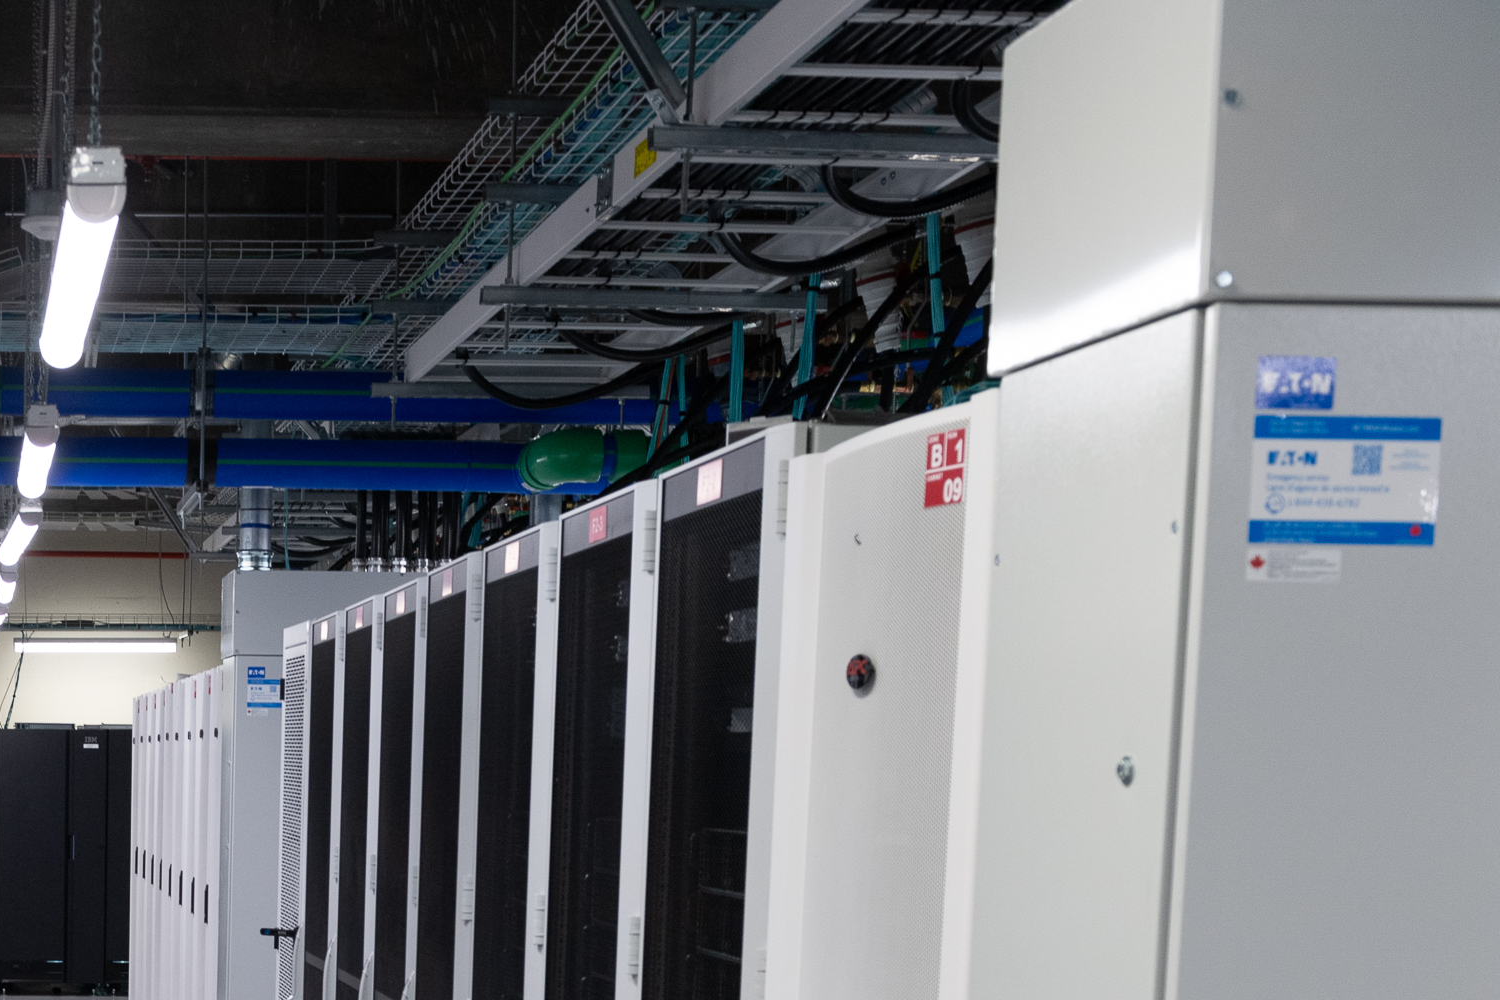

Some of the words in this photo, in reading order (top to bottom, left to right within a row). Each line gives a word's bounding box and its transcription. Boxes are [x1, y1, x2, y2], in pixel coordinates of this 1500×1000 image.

[931, 443, 943, 469] B
[954, 438, 964, 464] 1
[943, 476, 963, 504] 09
